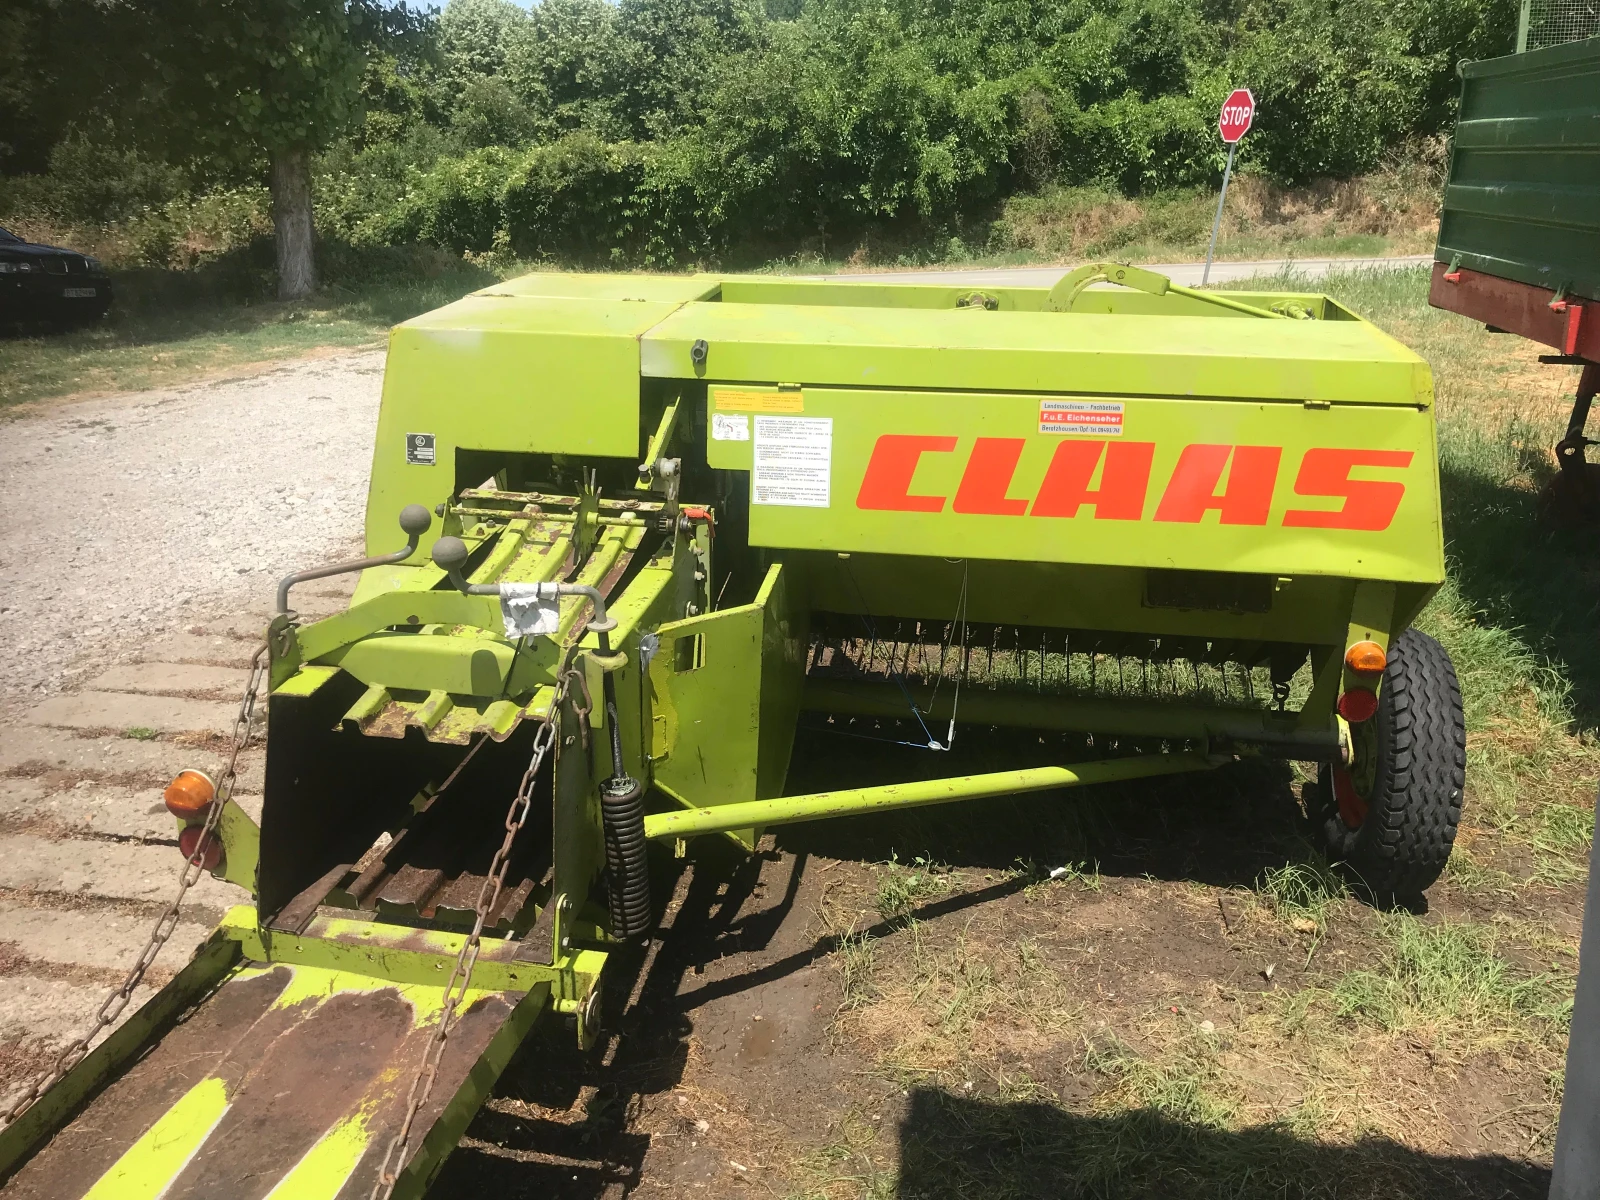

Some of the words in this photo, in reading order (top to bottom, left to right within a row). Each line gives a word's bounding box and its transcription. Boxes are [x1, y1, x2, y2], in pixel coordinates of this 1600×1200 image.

[1221, 106, 1250, 126] STOP
[1067, 414, 1121, 423] Eichenseher
[856, 434, 1415, 532] CLAAS
